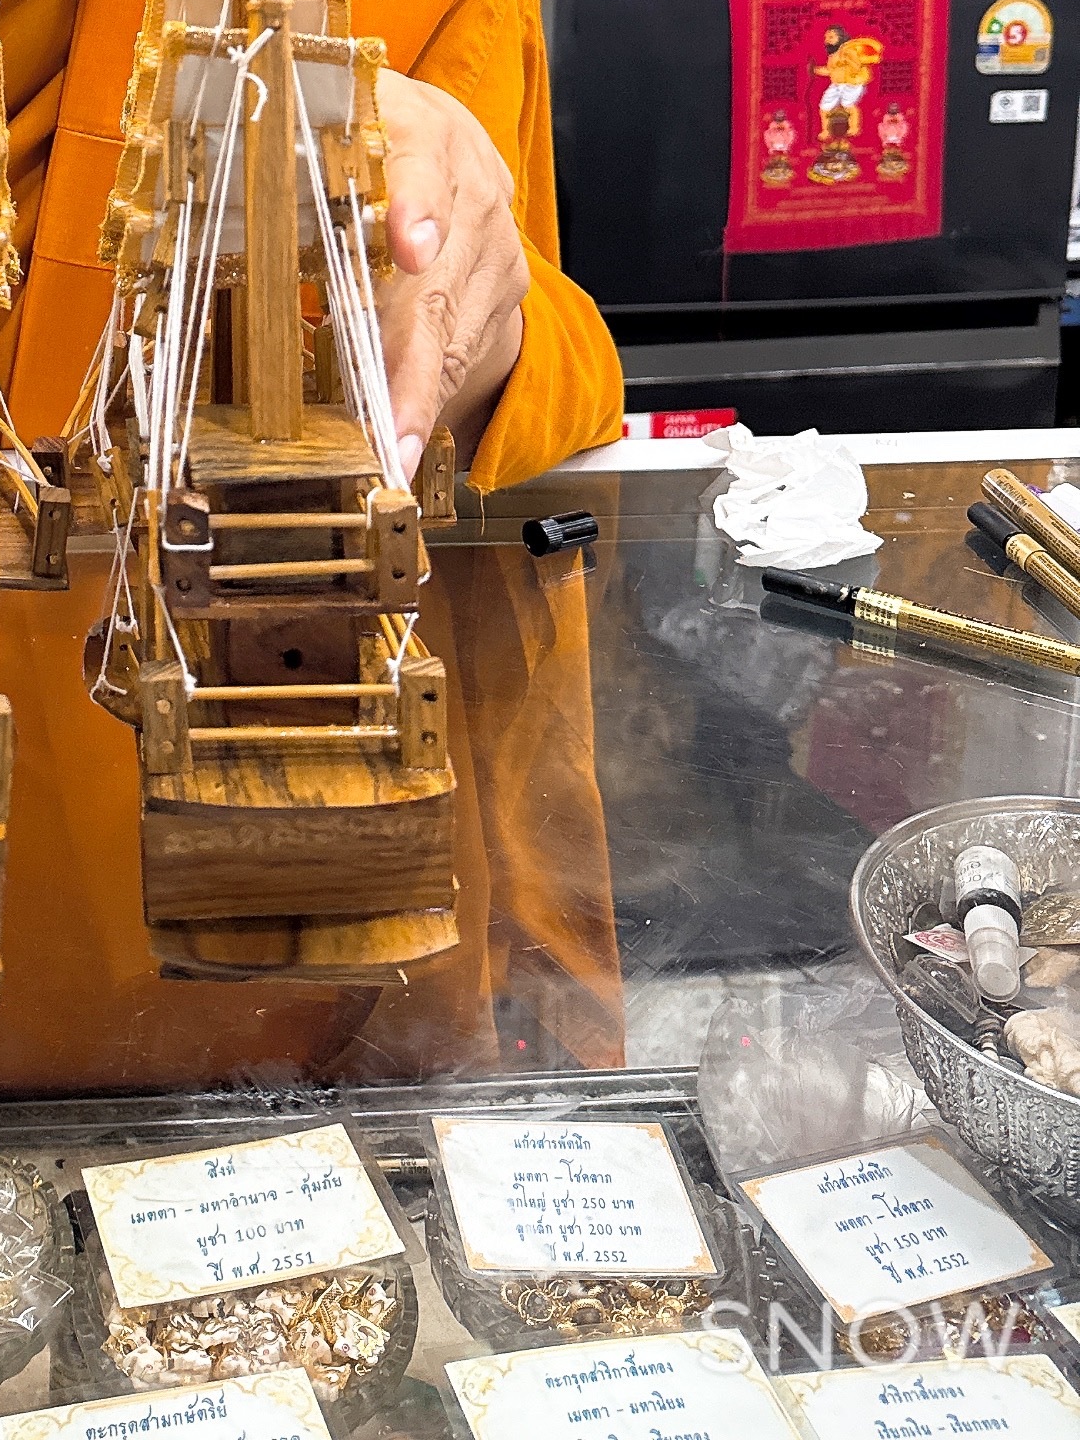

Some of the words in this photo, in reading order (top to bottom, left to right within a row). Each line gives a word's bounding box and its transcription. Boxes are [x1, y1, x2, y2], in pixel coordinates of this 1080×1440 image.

[204, 1152, 236, 1178] สิงห์
[514, 1172, 548, 1183] เมตตา
[560, 1158, 612, 1184] โชคลาภ
[130, 1207, 176, 1225] เมตตา
[200, 1188, 278, 1214] มหาอำนาจ
[300, 1165, 342, 1202] คุ้มภัย
[552, 1191, 576, 1216] บูชา
[582, 1198, 606, 1210] 250
[612, 1198, 635, 1210] บาท
[836, 1213, 873, 1232] เมตตา
[872, 1192, 935, 1219] โชคลาภ
[196, 1224, 226, 1257] บูชา
[235, 1224, 267, 1242] 100
[274, 1218, 305, 1236] บาท
[558, 1216, 582, 1243] บูชา
[589, 1224, 613, 1236] 200
[619, 1224, 642, 1236] บาท
[866, 1232, 890, 1263] บูชา
[894, 1233, 920, 1250] 150
[924, 1226, 948, 1242] บาท
[206, 1258, 224, 1282] ปี
[232, 1253, 266, 1278] พ.ศ.
[273, 1251, 316, 1272] 2551
[562, 1242, 588, 1262] พ.ศ.
[594, 1250, 628, 1263] 2552
[882, 1263, 902, 1284] ปี
[906, 1254, 934, 1281] พ.ศ.
[934, 1252, 970, 1274] 2552
[568, 1405, 610, 1424] เมตตา
[628, 1390, 686, 1416] มหานิยม
